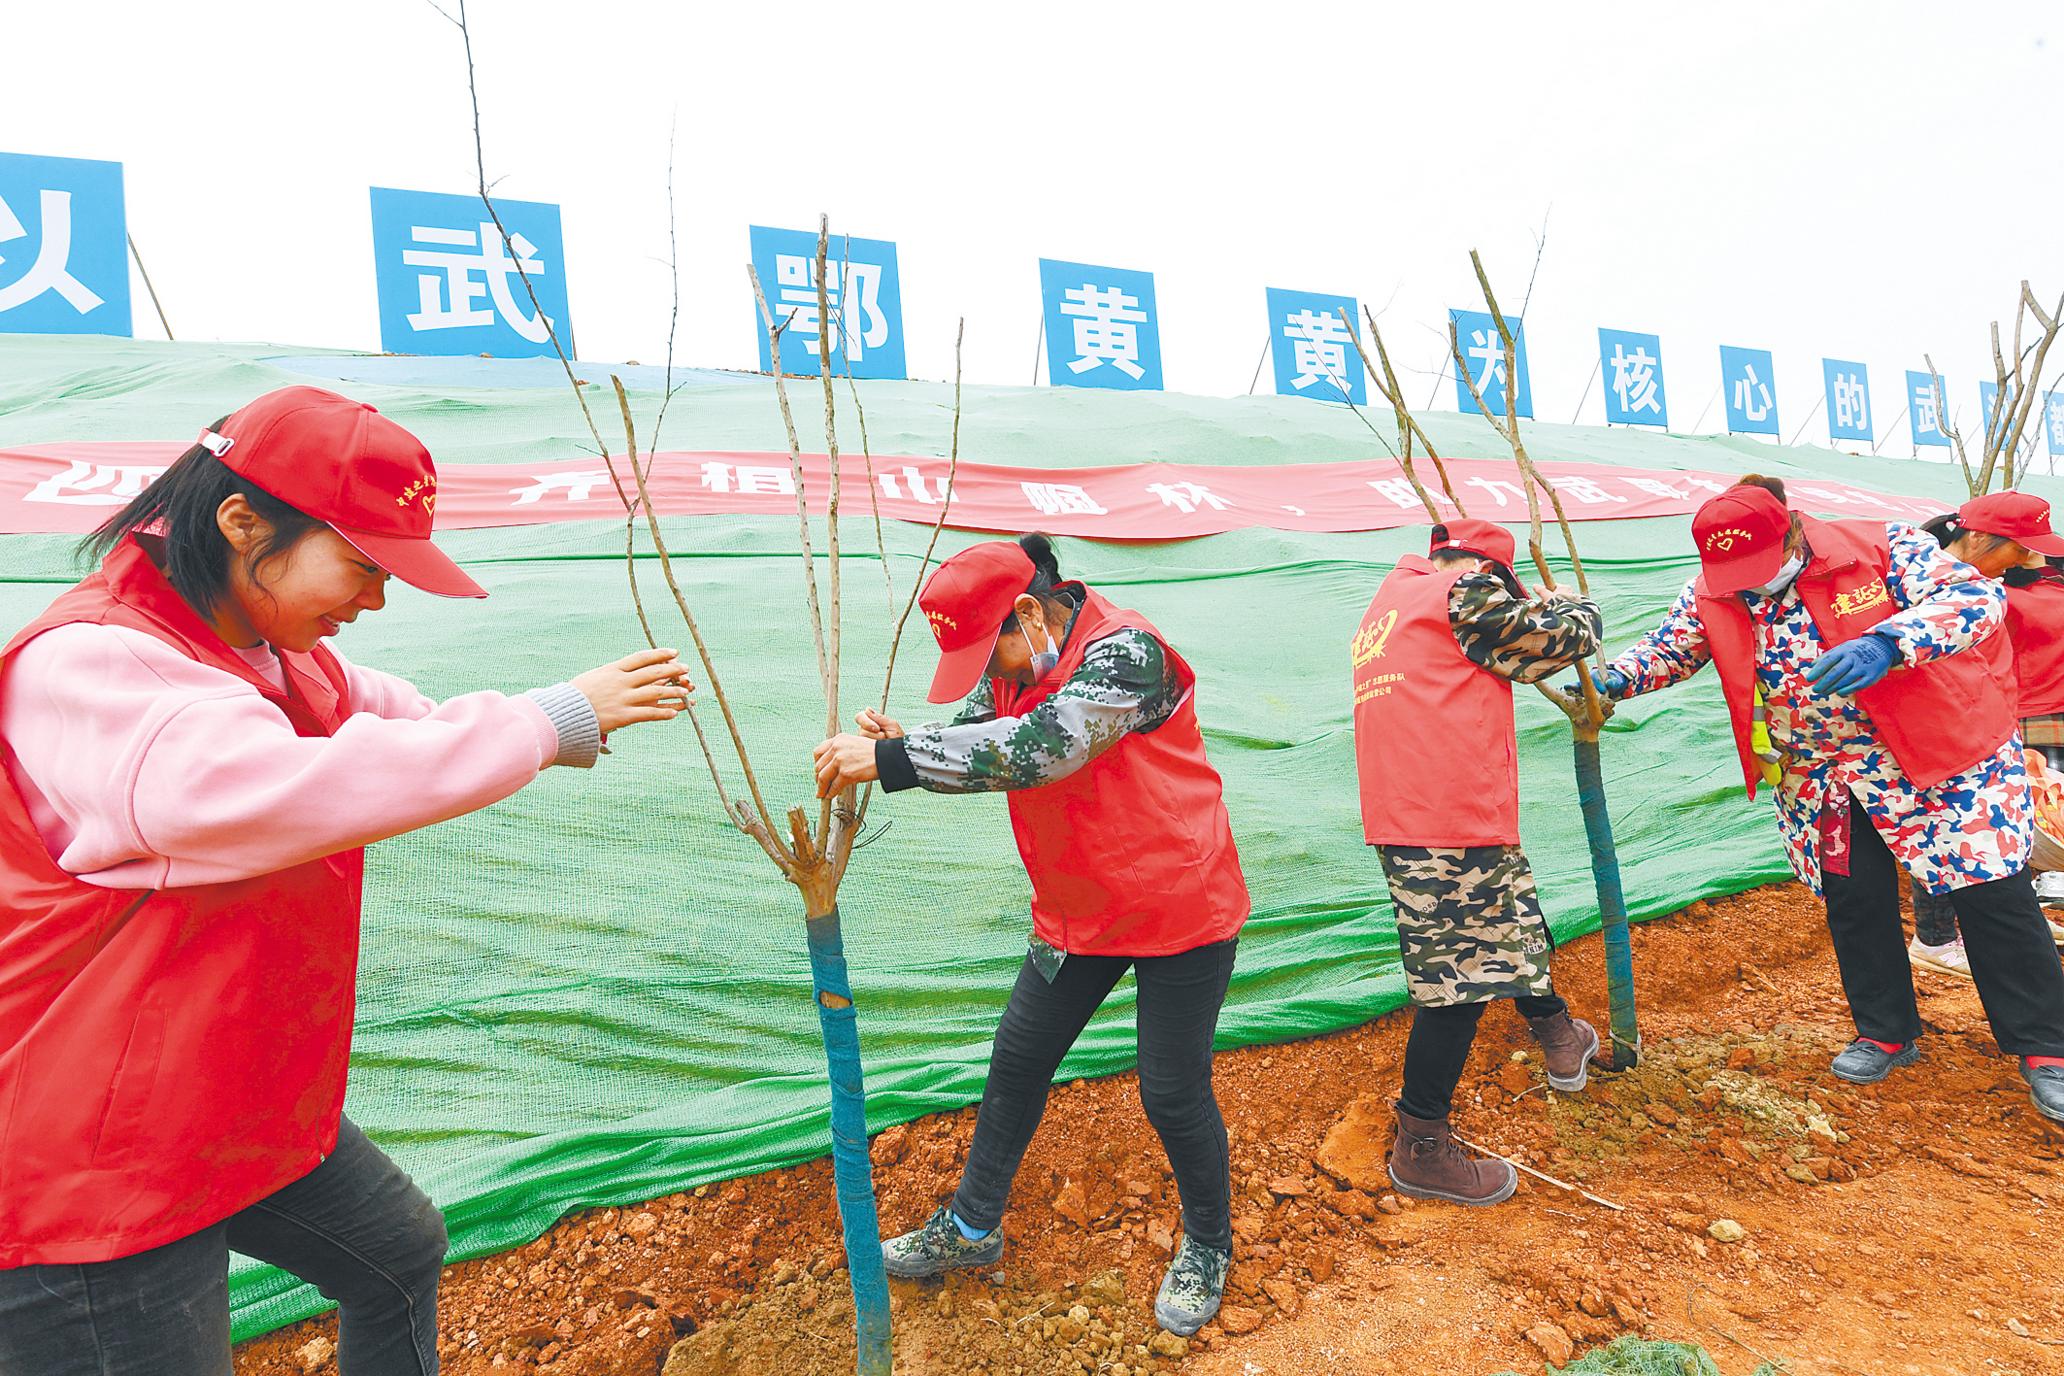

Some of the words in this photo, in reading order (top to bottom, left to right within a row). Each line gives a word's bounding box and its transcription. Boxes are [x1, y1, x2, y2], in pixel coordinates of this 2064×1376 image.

[403, 222, 554, 343] 武
[775, 254, 890, 362] 鄂
[1060, 283, 1147, 381] 黄
[1283, 309, 1353, 394] 黄
[1468, 329, 1519, 402] 为
[1610, 344, 1661, 414] 核
[1734, 363, 1773, 421] 心
[1834, 373, 1866, 430] 的
[1915, 384, 1947, 438] 武
